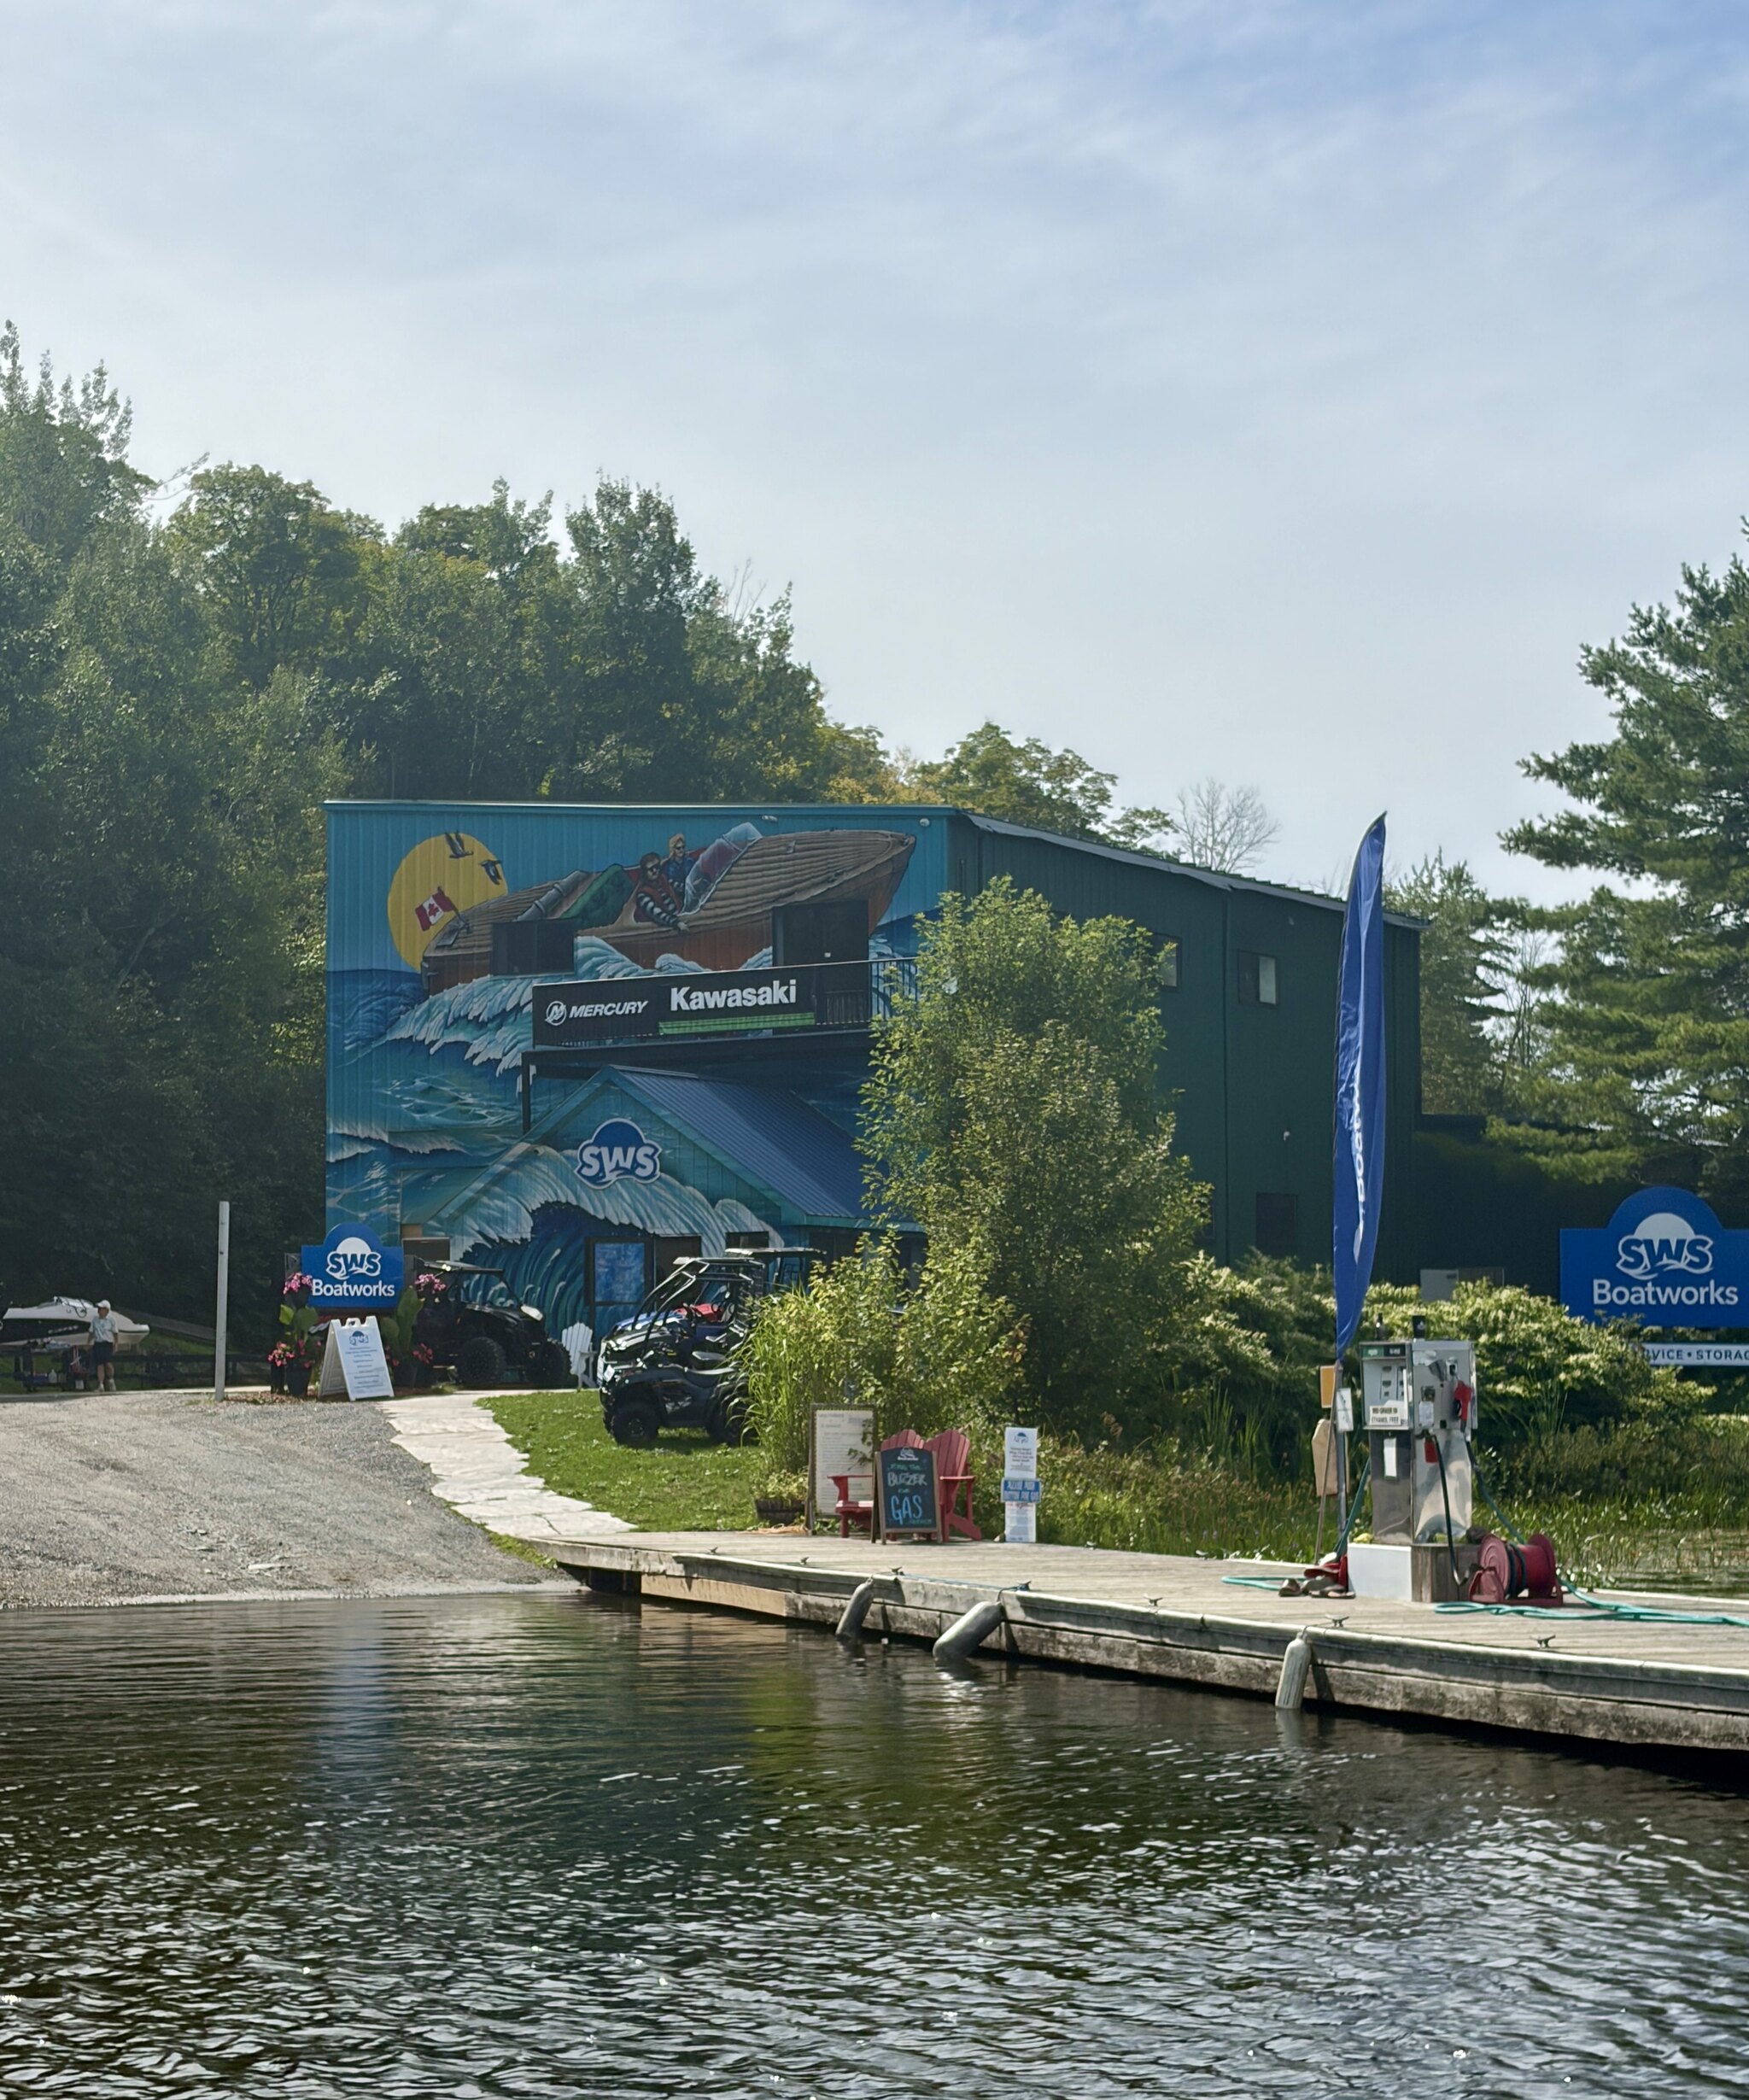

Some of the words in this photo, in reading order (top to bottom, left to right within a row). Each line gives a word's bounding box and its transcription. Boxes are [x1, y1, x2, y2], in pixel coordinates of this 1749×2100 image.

[569, 1000, 649, 1019] MERCURY
[670, 979, 797, 1012] Kawasaki
[578, 1144, 658, 1185] SWS
[326, 1250, 382, 1279] SWS
[1617, 1235, 1713, 1280] SWS
[312, 1278, 395, 1297] Boatworks
[1593, 1278, 1739, 1305] Boatworks
[888, 1471, 927, 1486] BUZZER
[891, 1495, 922, 1525] GAS
